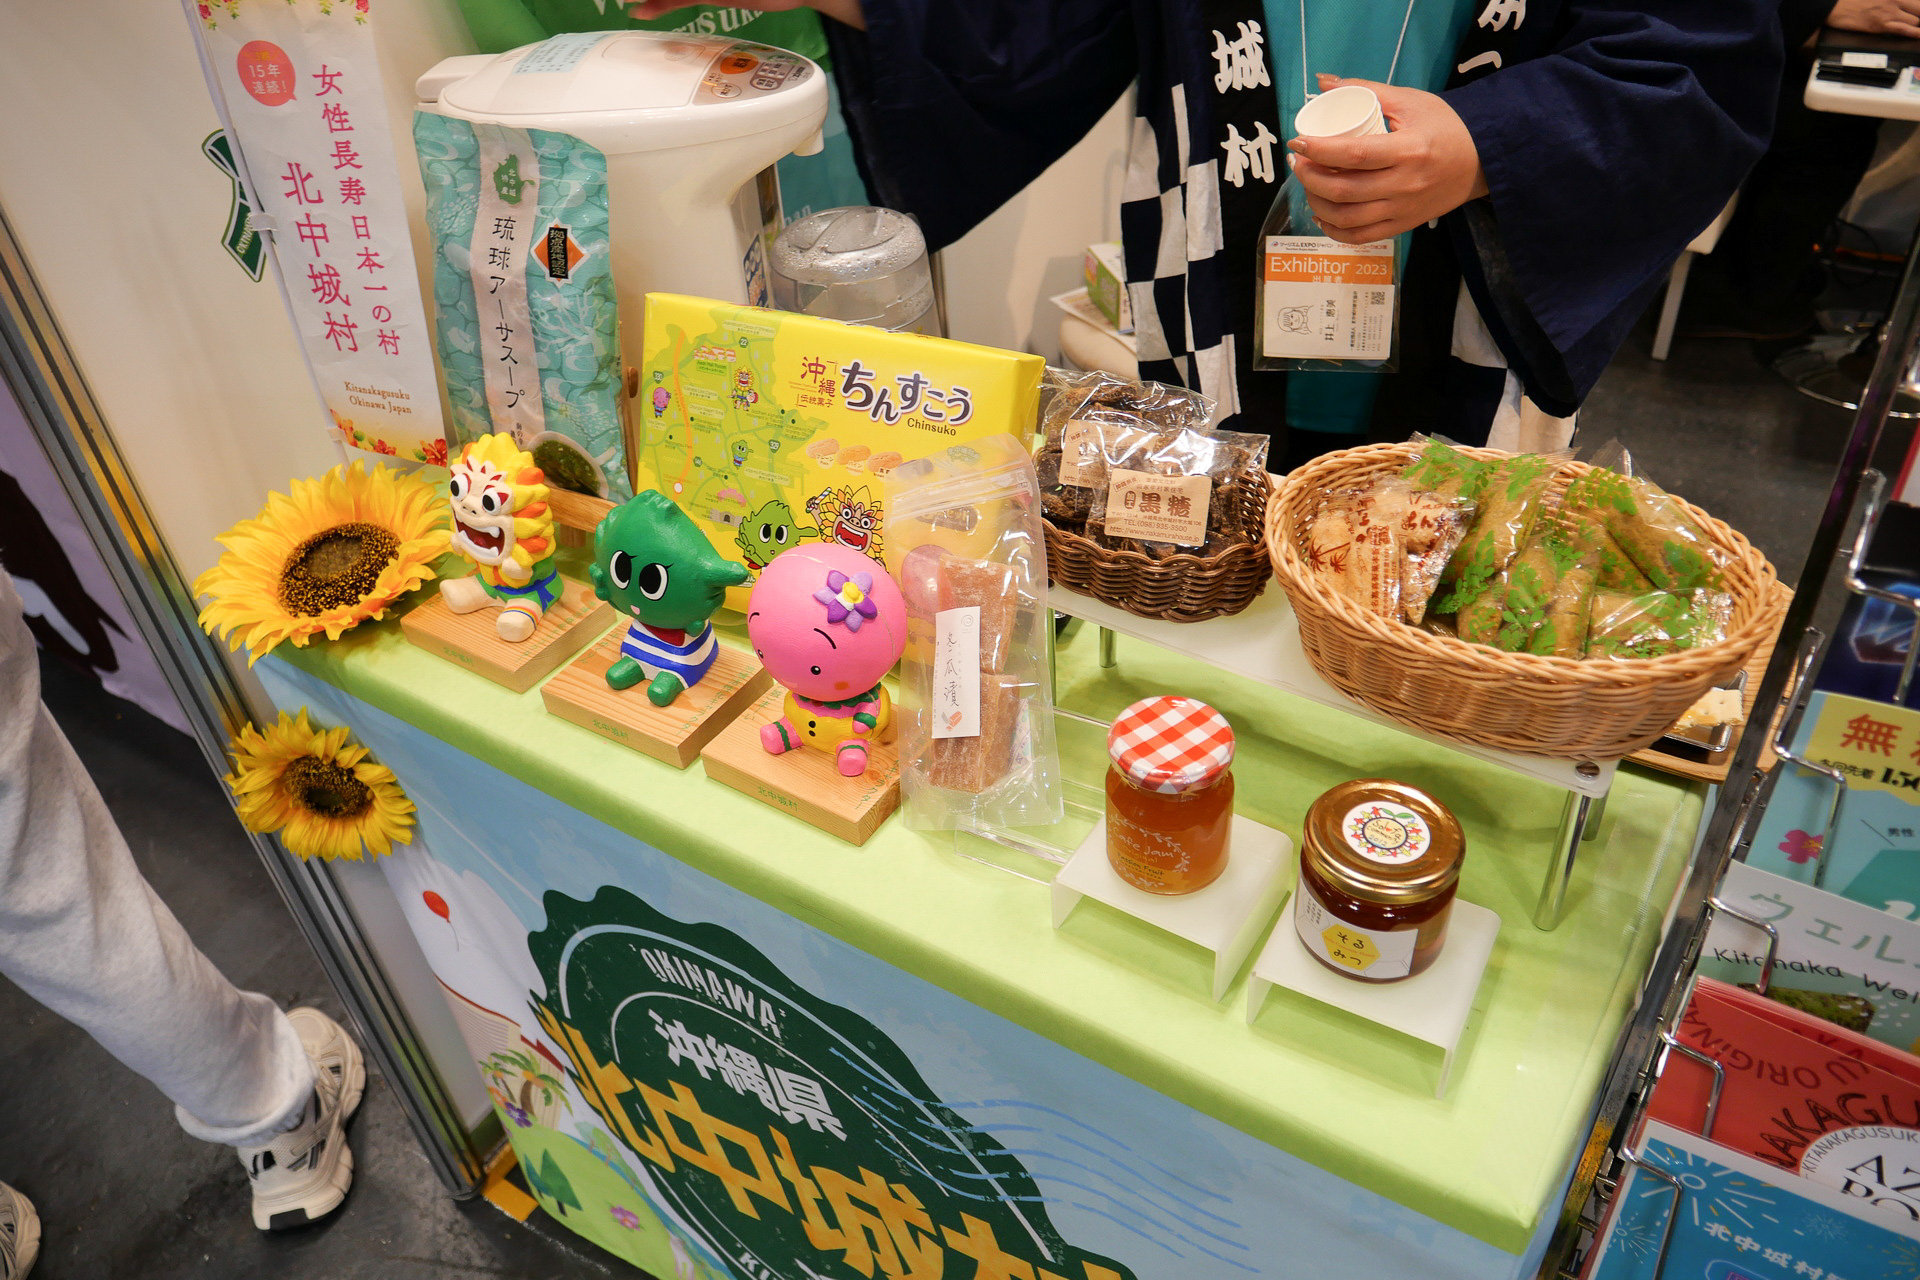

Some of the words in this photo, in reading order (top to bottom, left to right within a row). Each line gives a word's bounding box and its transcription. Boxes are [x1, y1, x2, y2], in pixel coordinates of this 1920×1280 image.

[248, 63, 281, 78] 15年
[312, 64, 402, 356] 女性長寿日本一の村
[280, 161, 360, 354] 北中城村
[1271, 256, 1351, 274] Exhibitor
[1355, 264, 1388, 275] 2023
[488, 216, 525, 409] 琉球アーサスープ
[800, 356, 836, 398] 沖縄
[344, 380, 411, 400] Kitanakagusuku
[800, 394, 834, 408] 伝統菓子
[841, 359, 974, 425] ちんすこう
[349, 395, 386, 410] Okinawa
[388, 401, 412, 415] Japan
[907, 417, 957, 436] Chinsuko
[1138, 491, 1192, 518] 黒糖
[943, 631, 960, 707] 冬瓜漬
[1840, 713, 1920, 767] 無
[757, 786, 799, 812] 北中城村
[1369, 834, 1388, 846] 2012
[1887, 827, 1915, 838] 男性
[1143, 846, 1175, 858] Jam
[1143, 865, 1165, 876] Fruit
[1336, 931, 1365, 950] そる
[1750, 892, 1920, 970] ウェル
[1333, 949, 1362, 966] みつ
[640, 945, 783, 1039] OKINAWA
[648, 1006, 850, 1142] 沖縄県
